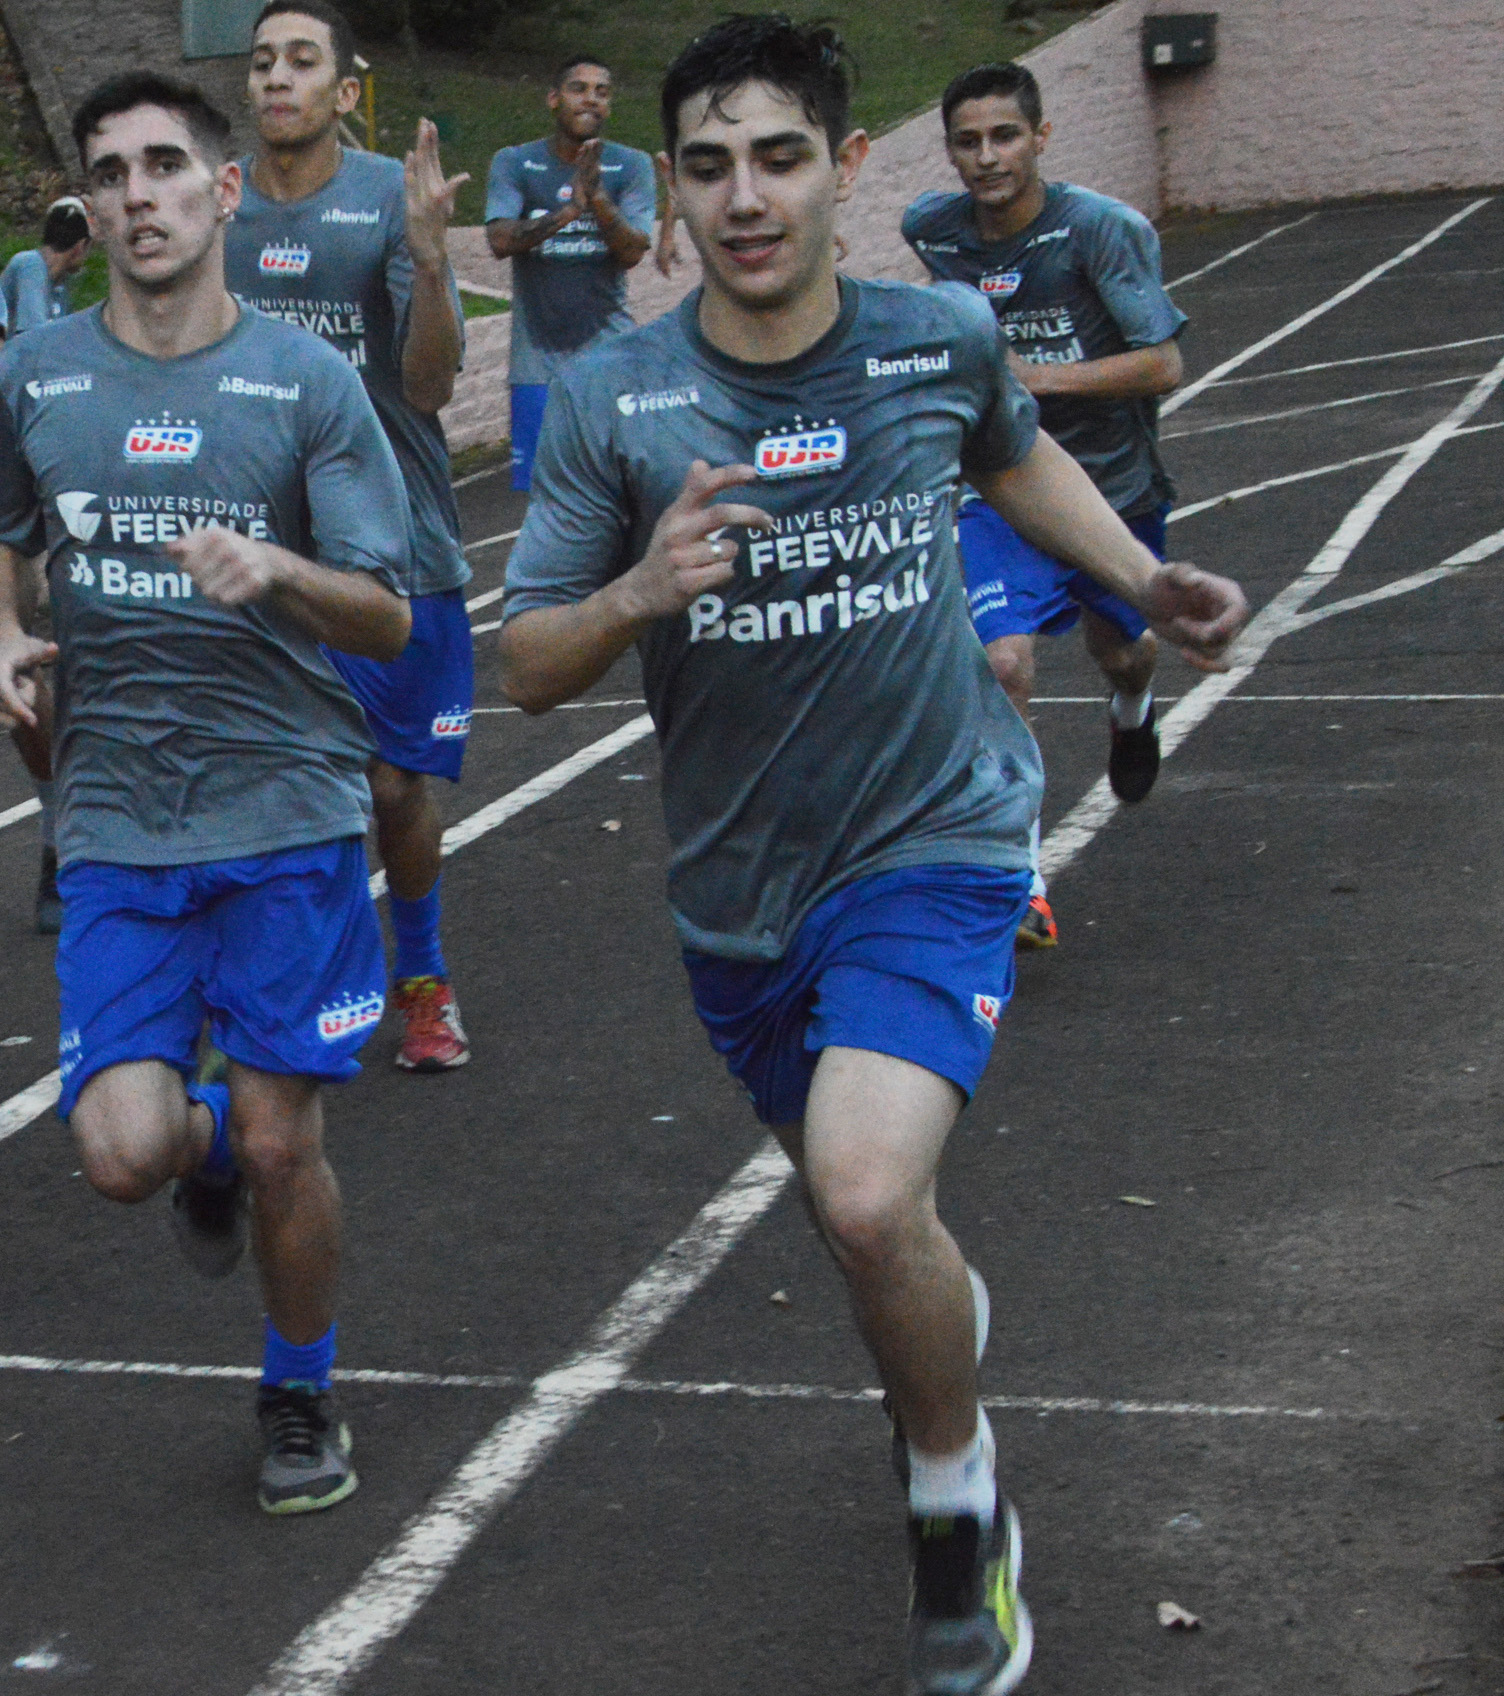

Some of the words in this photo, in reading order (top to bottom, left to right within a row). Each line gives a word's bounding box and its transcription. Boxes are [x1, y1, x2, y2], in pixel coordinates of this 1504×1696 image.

[268, 310, 366, 335] EVALE
[1004, 315, 1075, 343] EVALE
[865, 349, 950, 378] Banrisul
[1020, 336, 1084, 365] risul
[231, 376, 300, 401] Banrisul
[108, 495, 270, 519] UNIVERSIDADE
[747, 490, 935, 540] UNIVERSIDADE
[749, 510, 933, 577] FEEVALE
[688, 549, 931, 643] Banrisul
